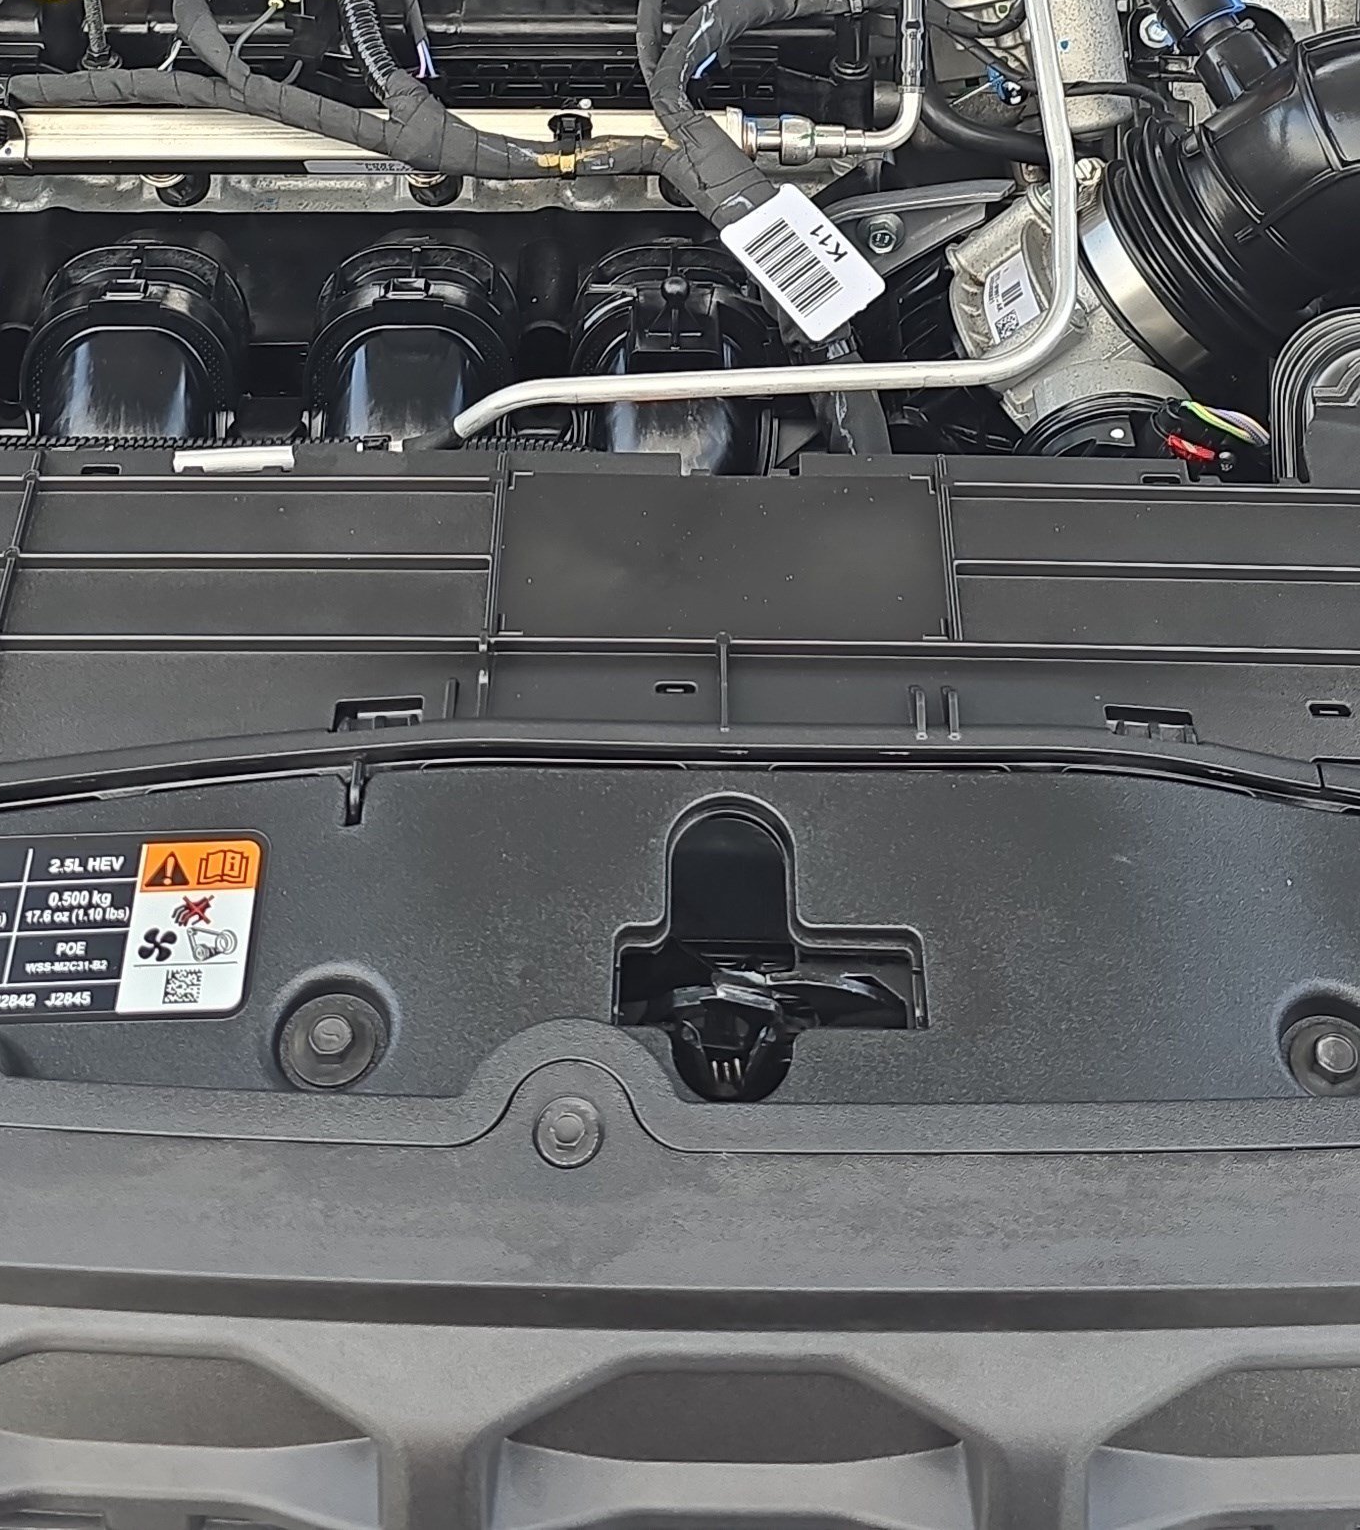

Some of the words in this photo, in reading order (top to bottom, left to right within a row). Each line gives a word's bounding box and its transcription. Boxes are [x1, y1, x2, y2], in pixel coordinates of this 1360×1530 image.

[810, 224, 848, 263] K11
[48, 856, 84, 874] 2.5L
[87, 856, 125, 872] HEV
[47, 891, 90, 908] 0.500
[92, 890, 112, 908] kg
[25, 910, 52, 925] 17.6
[54, 912, 70, 924] oz
[72, 908, 103, 925] (1.10
[105, 906, 131, 922] lbs)
[55, 941, 87, 957] POE
[44, 991, 91, 1008] J2845
